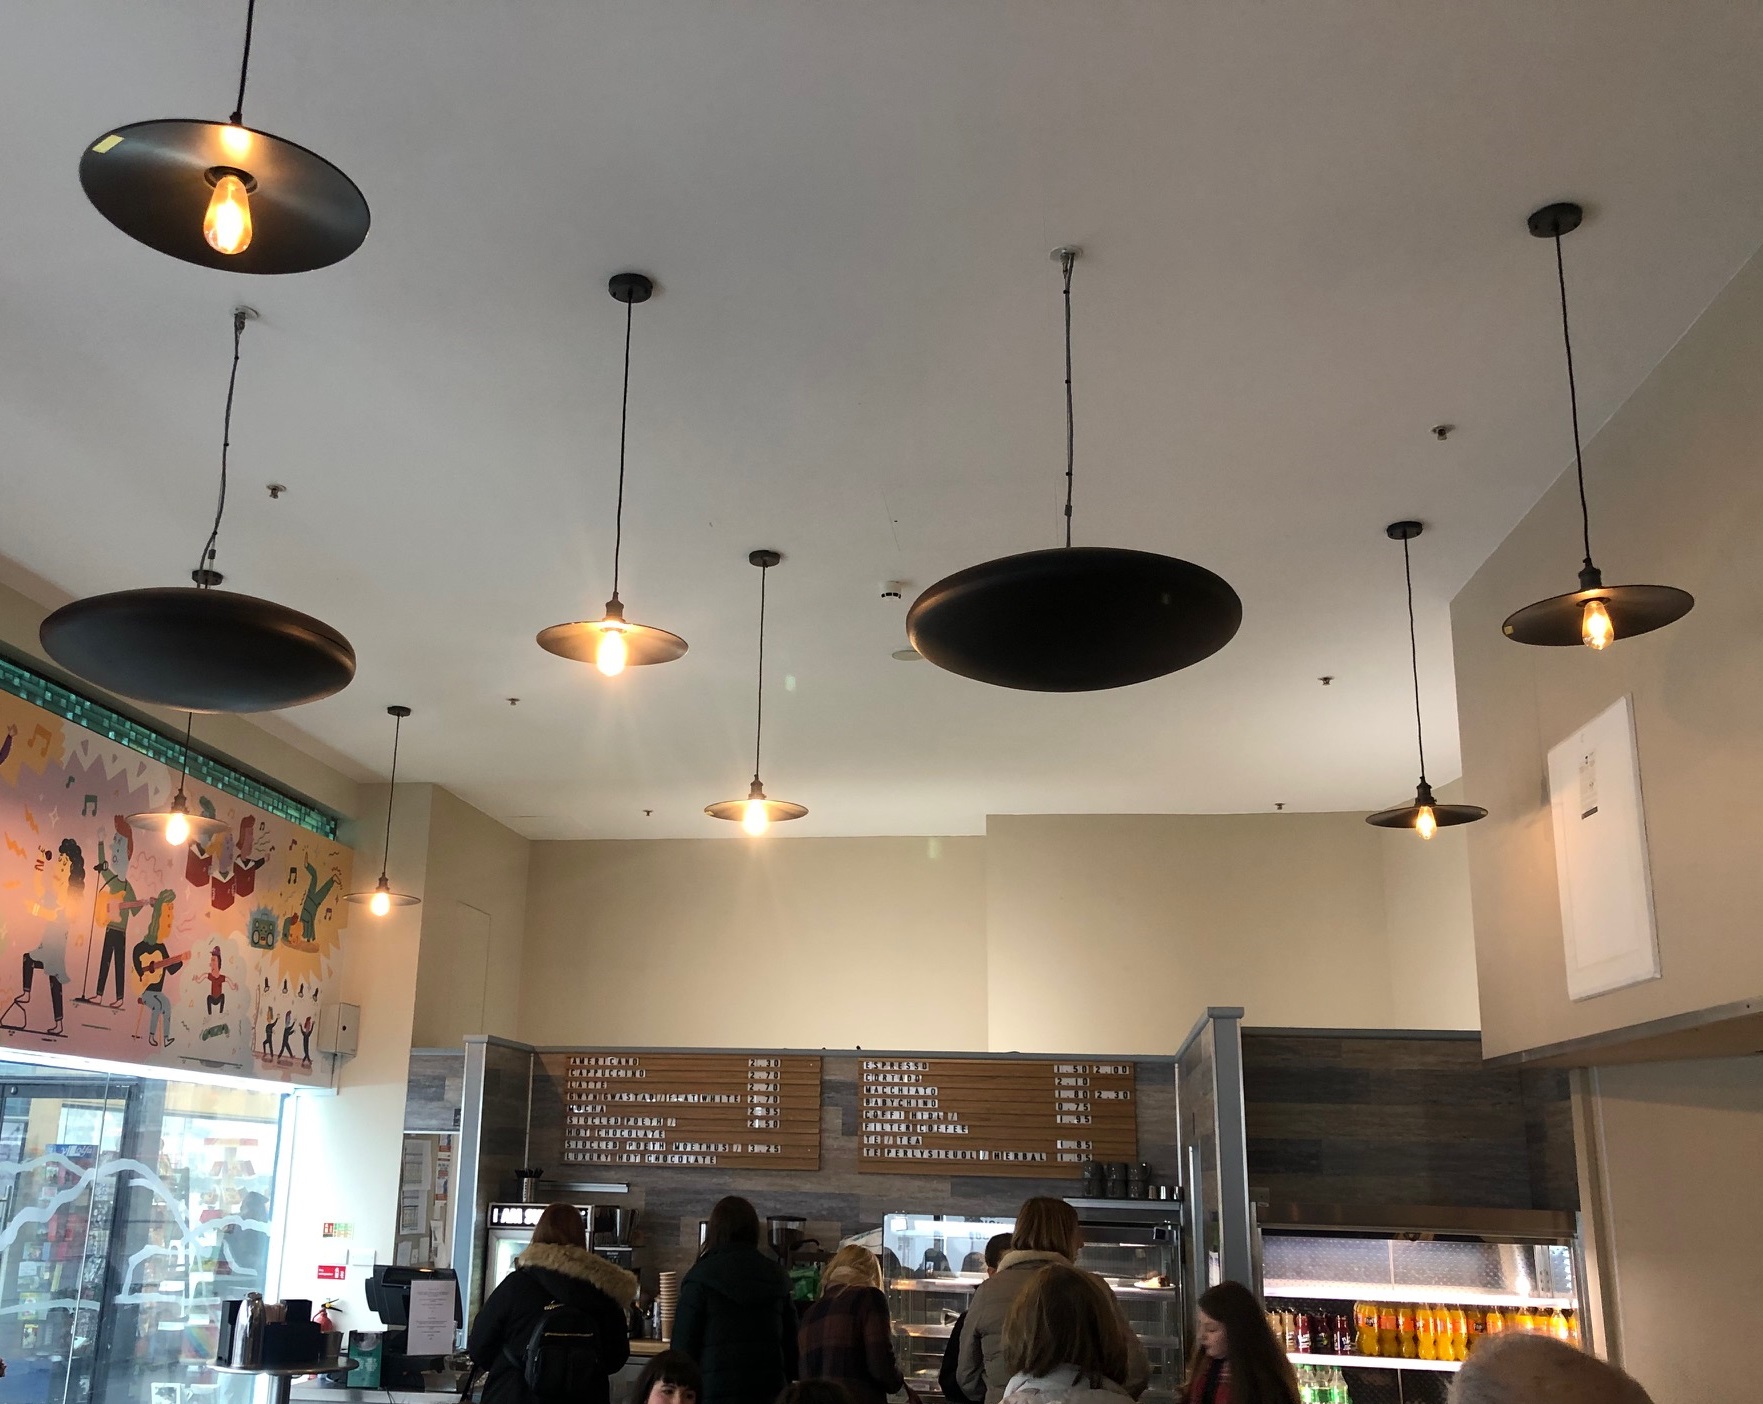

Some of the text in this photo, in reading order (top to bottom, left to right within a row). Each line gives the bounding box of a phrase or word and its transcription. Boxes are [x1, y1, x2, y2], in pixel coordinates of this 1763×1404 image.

[572, 1057, 779, 1067] AMERICANO 2.30
[865, 1062, 1127, 1074] ESPRESSO 1.50 2.00
[570, 1069, 779, 1079] CAPPUCCINO 2.70
[865, 1074, 920, 1082] CORTADO
[569, 1081, 778, 1091] LATTE 2.70
[865, 1086, 1128, 1099] MACCHIATO 1.80 2.30
[702, 1095, 739, 1103] WHITE
[749, 1095, 778, 1103] 2.70
[568, 1105, 604, 1113] MOCHA
[865, 1098, 1088, 1111] BABYCHINO 0.75
[568, 1116, 619, 1124] SIOCLED
[626, 1118, 662, 1126] POETH
[865, 1111, 902, 1119] COFFI
[911, 1112, 942, 1120] HIDL
[1060, 1115, 1090, 1123] 1.95
[864, 1123, 966, 1133] FILTER COFFEE
[597, 1129, 663, 1138] CHOCOLATE
[566, 1141, 617, 1149] SIOCLED
[628, 1142, 664, 1150] POETH
[674, 1143, 727, 1151] MOETHUS
[750, 1145, 779, 1153] 3.25
[865, 1135, 879, 1143] TE
[898, 1136, 920, 1144] TEA
[1060, 1141, 1091, 1149] 1.85
[566, 1153, 715, 1164] LUXURY HOT CHOCOLATE
[865, 1148, 879, 1156] TE
[994, 1152, 1045, 1160] HERBAL
